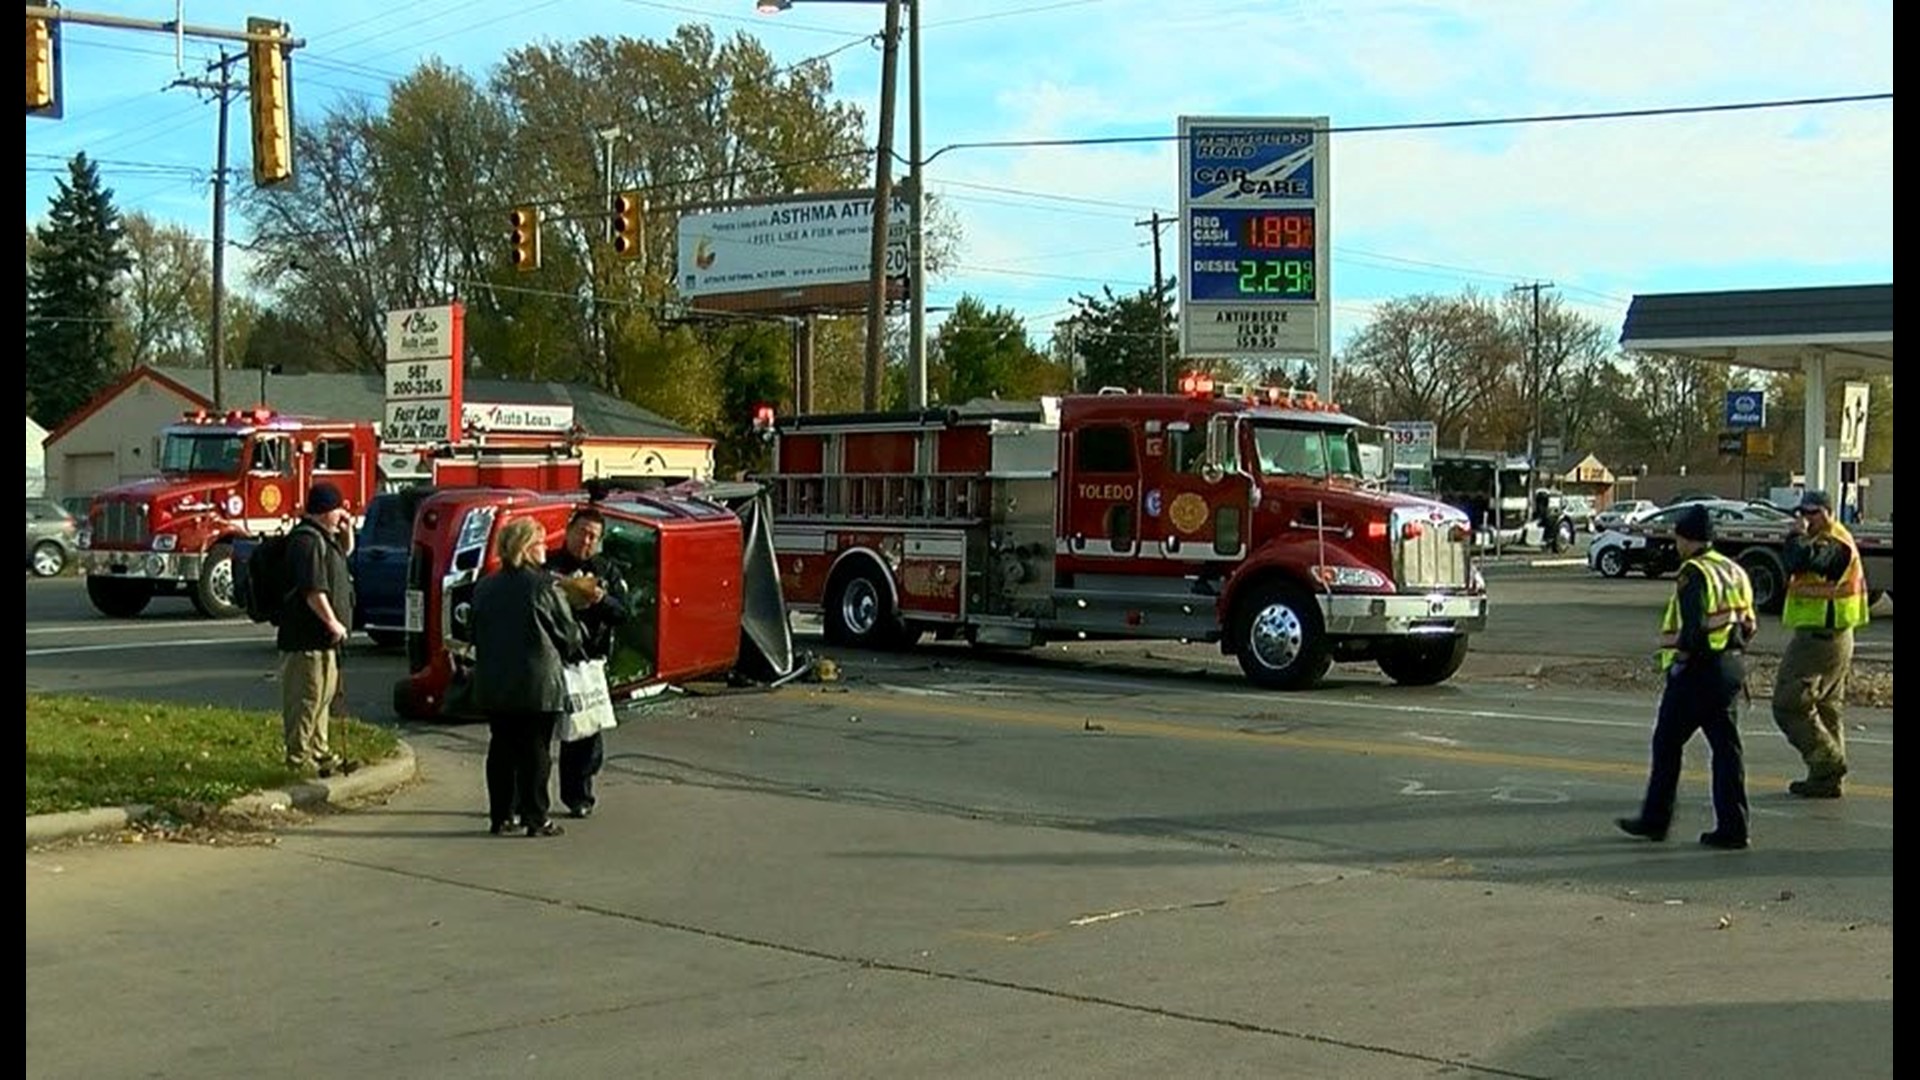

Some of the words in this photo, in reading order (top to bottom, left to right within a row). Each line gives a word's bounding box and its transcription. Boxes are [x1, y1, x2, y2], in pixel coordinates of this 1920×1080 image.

[1197, 146, 1256, 159] ROAD
[1195, 167, 1249, 185] CAR
[1239, 180, 1308, 195] CARE
[769, 204, 837, 226] ASTHMA
[1193, 229, 1230, 241] CASH
[1251, 216, 1302, 248] 1.89
[886, 249, 904, 270] 20
[1194, 260, 1239, 272] DIESEL
[1239, 260, 1302, 292] 2.29
[1216, 311, 1288, 322] ANTIFREEZE
[420, 335, 439, 348] Loan
[494, 409, 523, 426] Auto
[525, 410, 552, 427] Loan
[1078, 484, 1134, 500] TOLEDO
